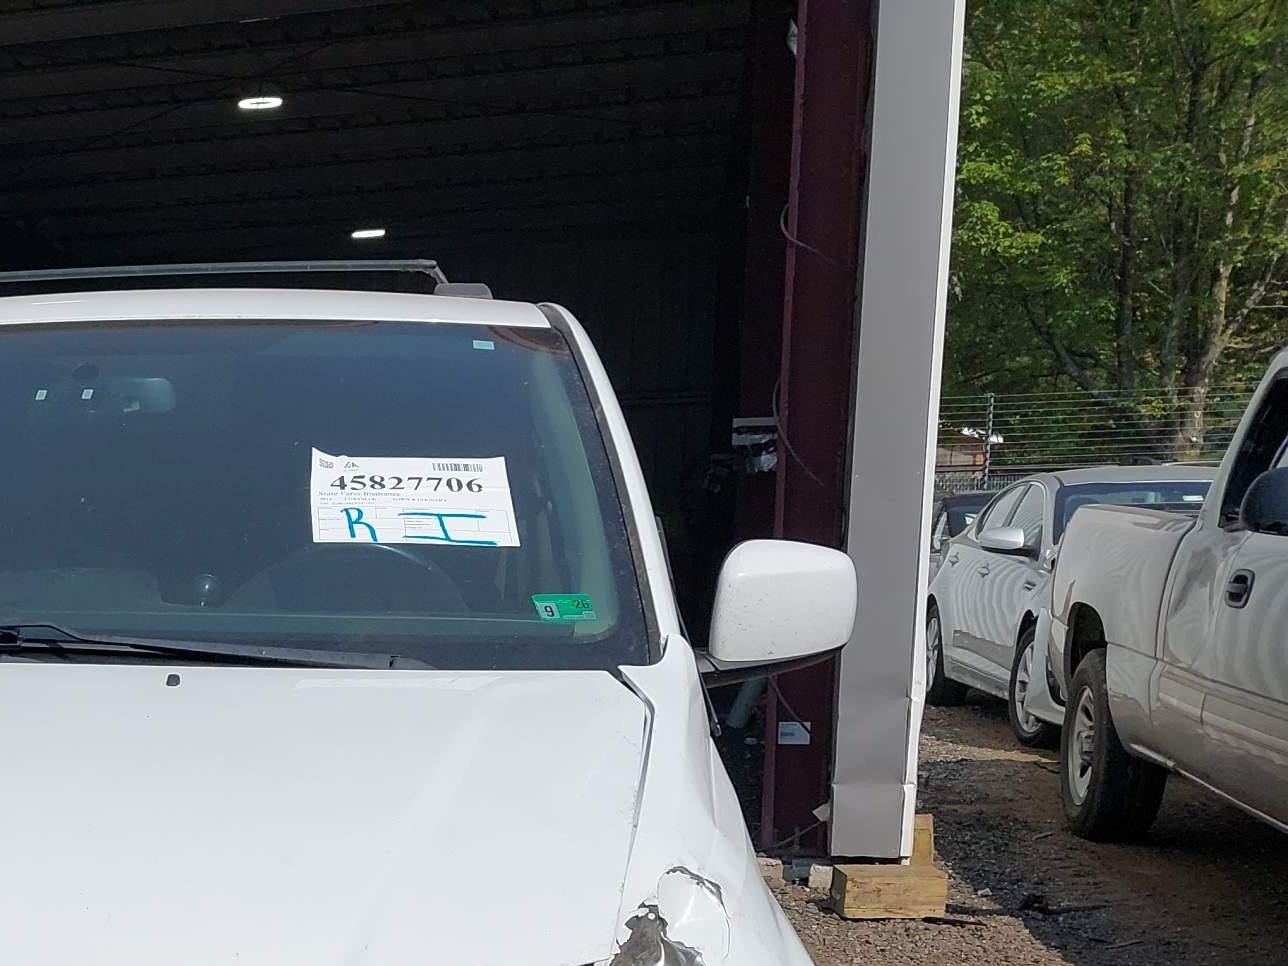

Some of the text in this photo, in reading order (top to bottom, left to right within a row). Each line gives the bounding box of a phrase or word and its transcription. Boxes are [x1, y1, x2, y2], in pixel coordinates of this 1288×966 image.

[330, 474, 483, 493] 45827706
[340, 507, 378, 542] R
[544, 605, 555, 618] 9
